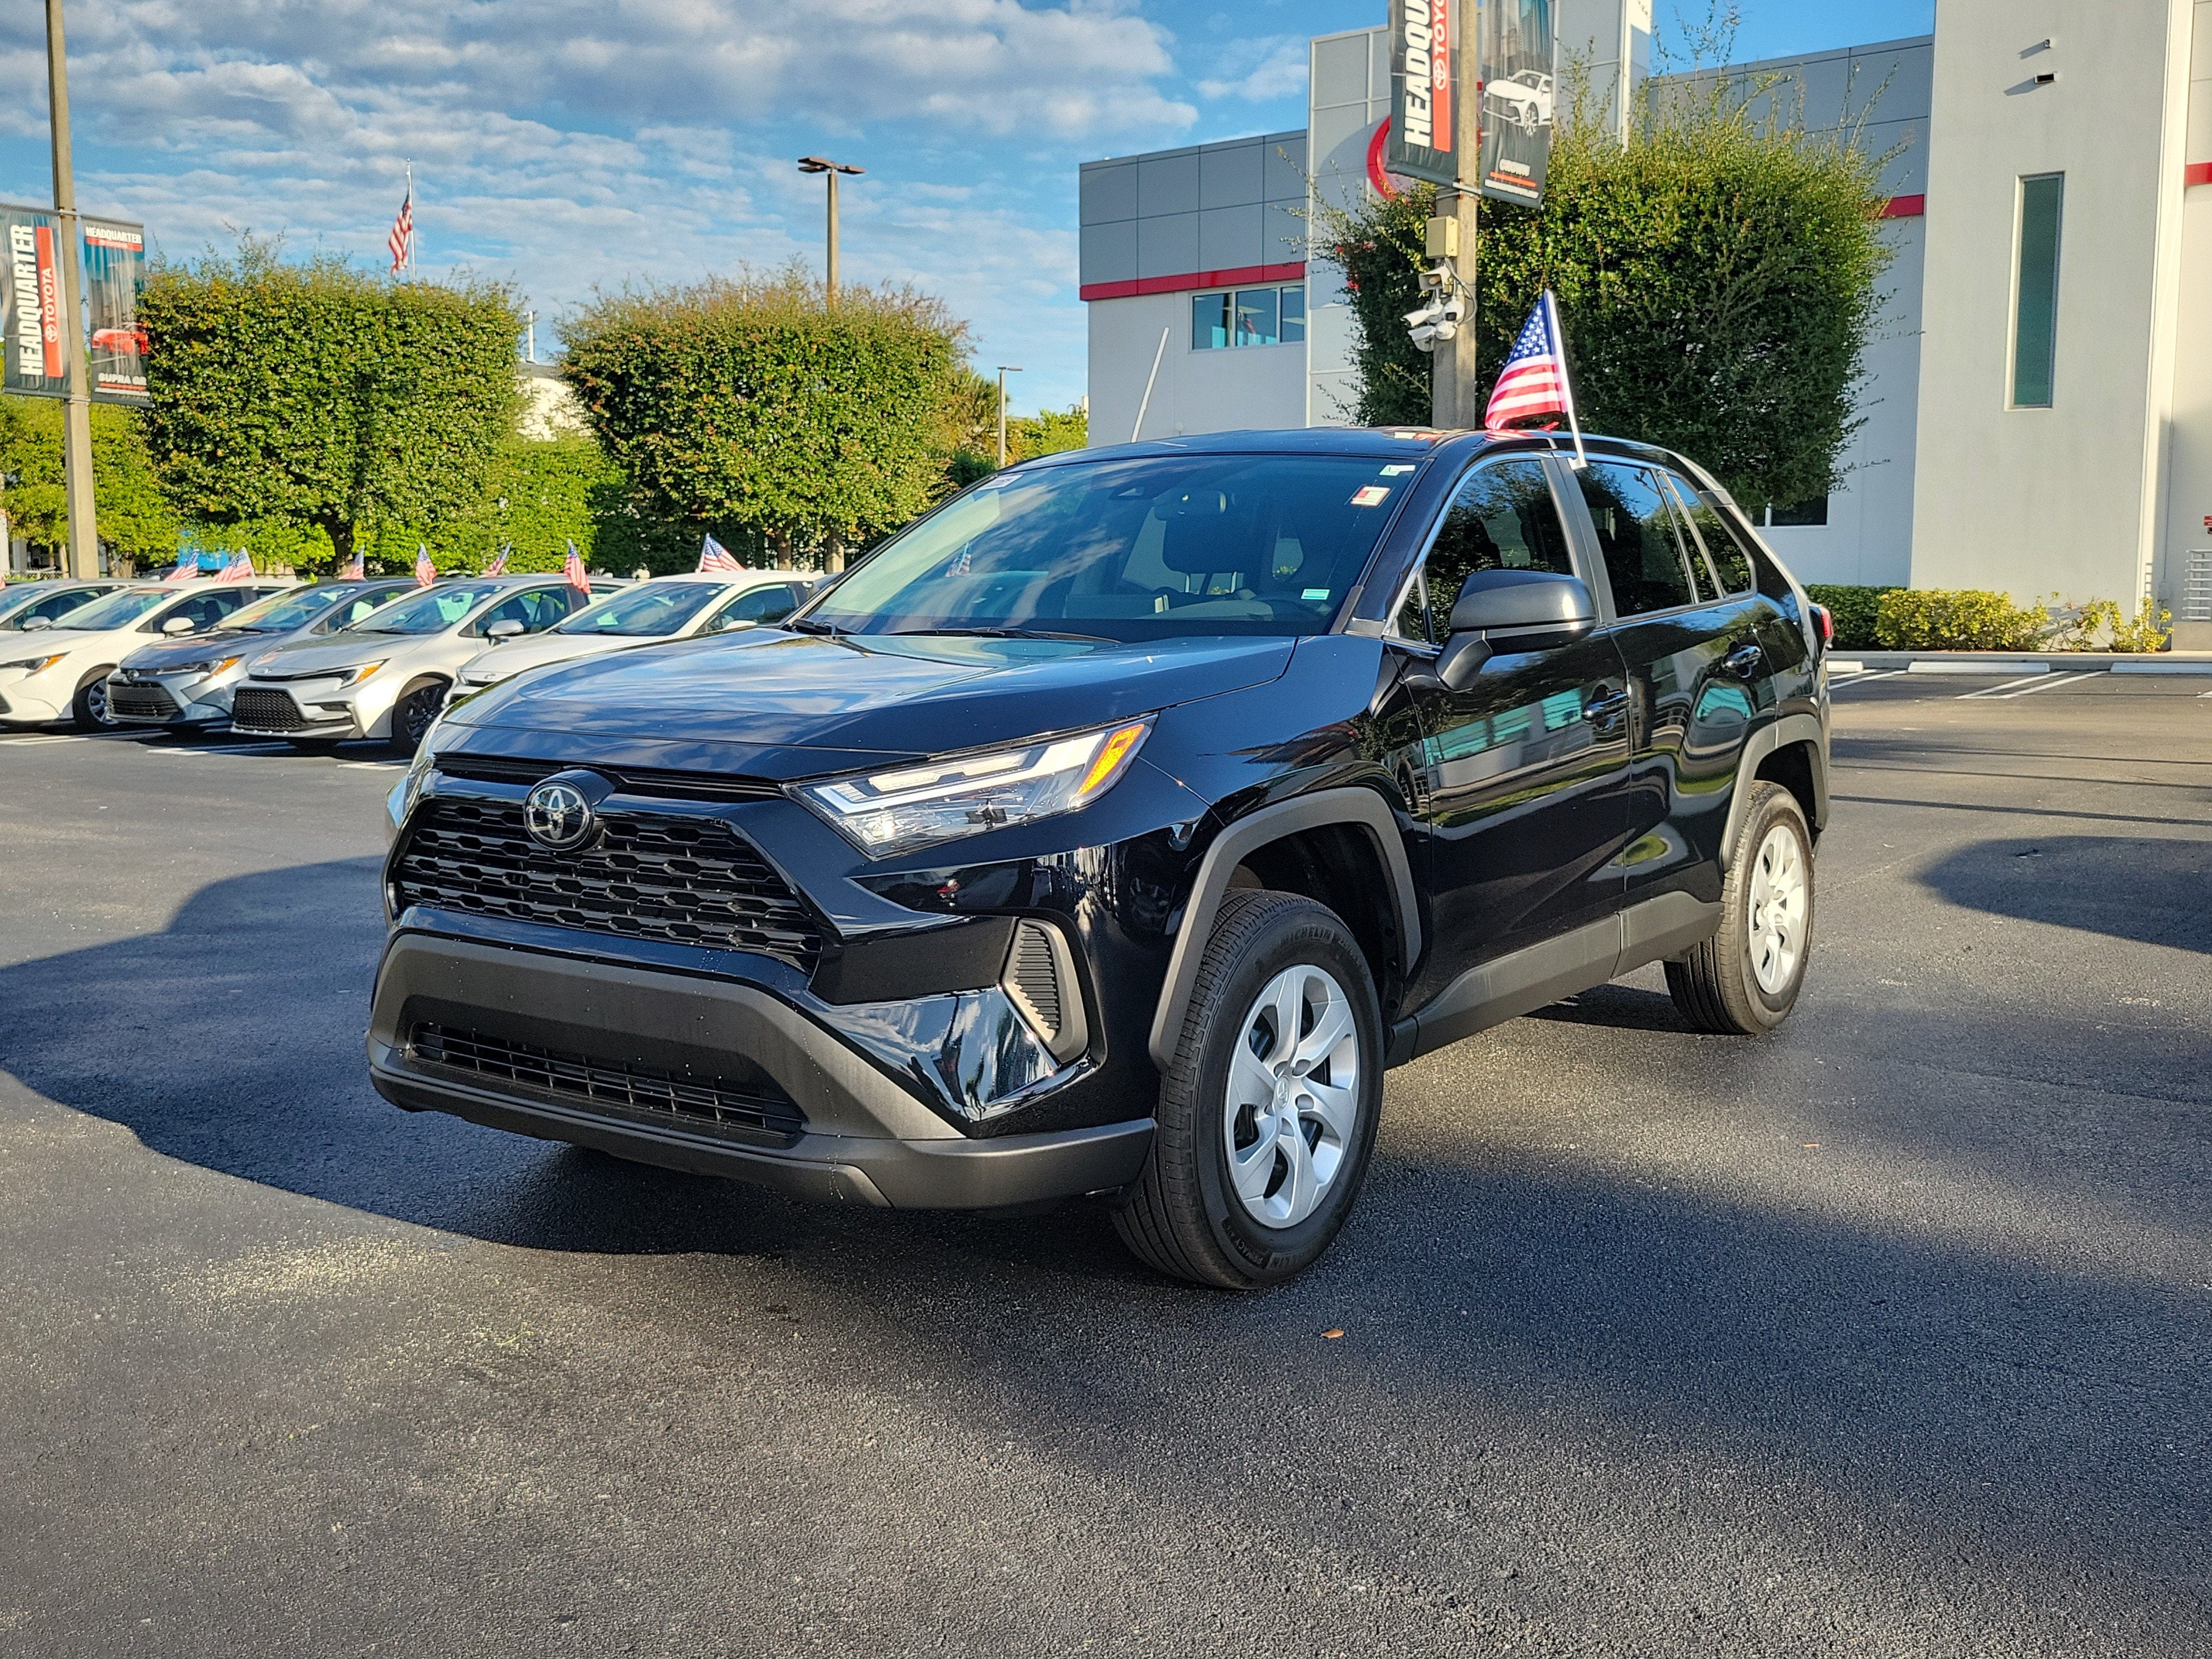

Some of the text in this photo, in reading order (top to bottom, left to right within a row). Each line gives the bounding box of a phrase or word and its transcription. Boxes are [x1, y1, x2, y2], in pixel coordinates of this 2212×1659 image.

[1404, 0, 1433, 147] HEADQU
[86, 227, 142, 244] HEADQUARTER
[10, 224, 43, 376] HEADQUARTER
[42, 267, 57, 324] TOYOTA
